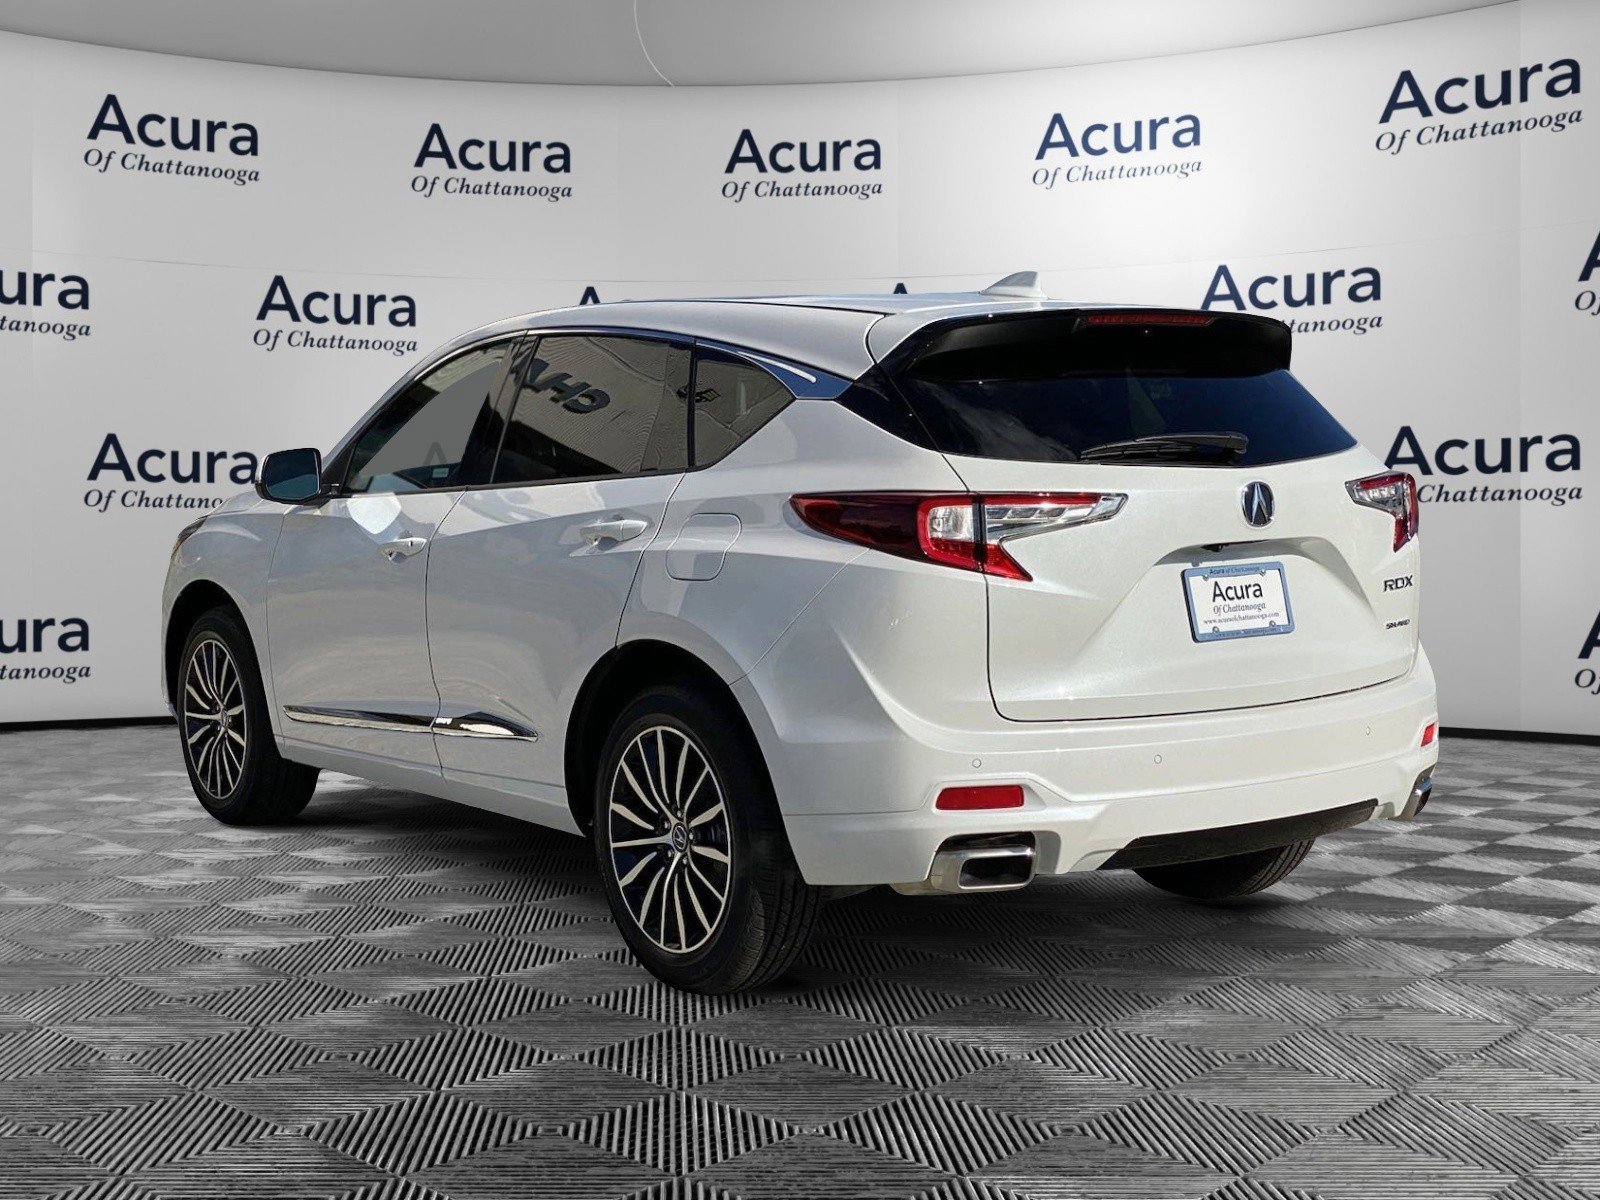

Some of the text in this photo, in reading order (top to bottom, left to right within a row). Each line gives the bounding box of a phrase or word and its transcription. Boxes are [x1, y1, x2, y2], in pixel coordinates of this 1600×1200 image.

[1379, 57, 1582, 125] Acura
[87, 93, 259, 157] Acura
[1035, 112, 1202, 161] Acura
[1375, 109, 1585, 156] Of Chattanooga
[84, 148, 261, 187] Of Chattanooga
[414, 122, 572, 175] Acura
[723, 128, 882, 175] Acura
[410, 175, 573, 203] Of Chattanooga
[721, 180, 883, 204] Of Chattanooga
[1032, 161, 1203, 190] Of Chattanooga
[0, 269, 89, 310] ura
[256, 274, 417, 328] Acura
[1200, 264, 1382, 312] Acura
[0, 315, 91, 341] tanooga
[252, 328, 419, 357] Of Chattanooga
[87, 432, 258, 485] Acura
[1384, 425, 1581, 476] Acura
[84, 488, 224, 514] Of Chattano
[1417, 483, 1583, 507] Chattanooga
[1212, 581, 1263, 602] Acura
[1383, 574, 1413, 592] RDX
[1213, 602, 1266, 616] Of Chattanooga
[0, 617, 89, 654] ura
[0, 664, 91, 685] tanooga
